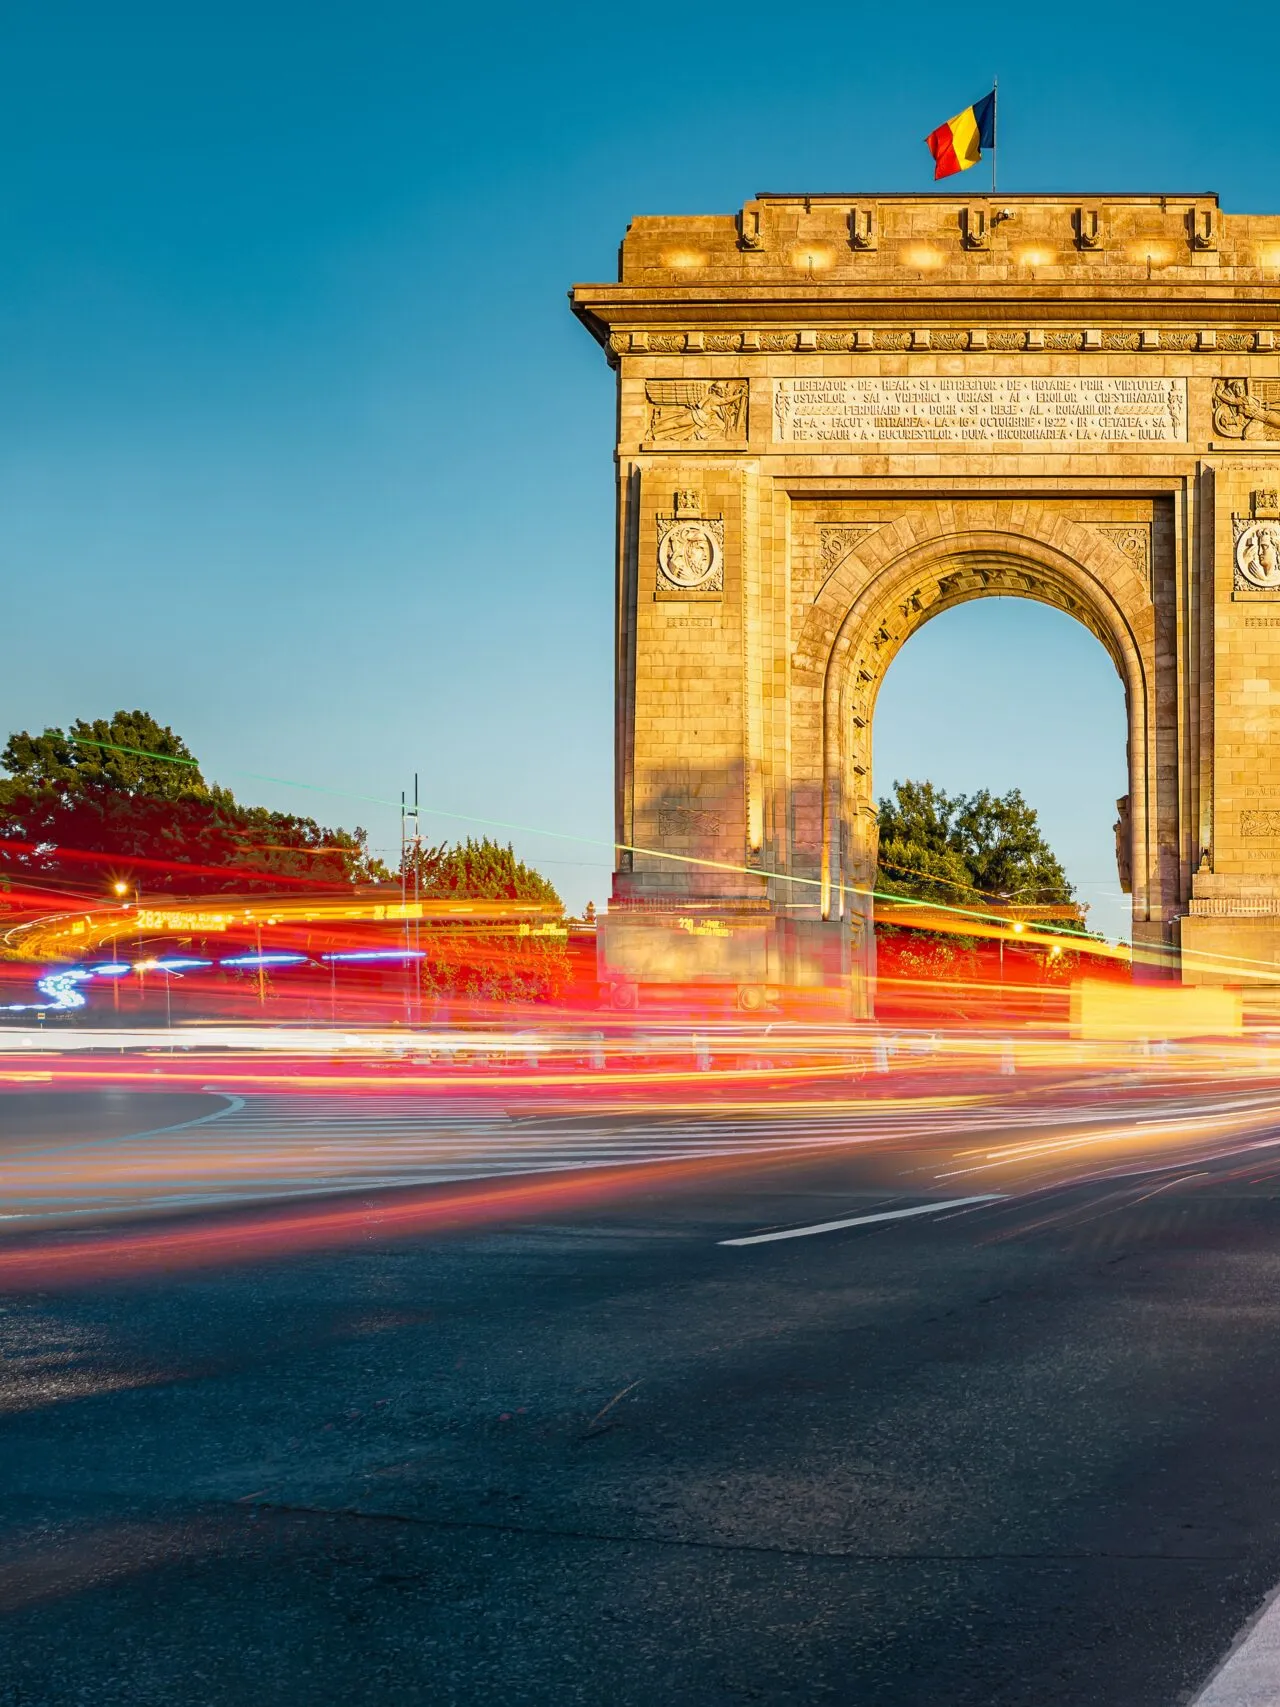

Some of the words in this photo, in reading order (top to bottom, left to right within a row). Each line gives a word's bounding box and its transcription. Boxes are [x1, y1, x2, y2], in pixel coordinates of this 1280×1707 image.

[794, 380, 847, 391] LIBERATOR
[858, 380, 872, 391] DE
[1007, 380, 1021, 391] DE
[1031, 380, 1071, 391] HOTARE
[1080, 380, 1104, 391] PRIN
[1114, 380, 1165, 391] VIRTUTEA
[895, 393, 941, 403] VREDNICI
[1009, 392, 1021, 403] AI
[1036, 392, 1078, 403] EROILOR
[844, 405, 901, 415] FERDINAND
[913, 405, 917, 415] I
[929, 405, 957, 415] DOMN
[990, 405, 1017, 415] REGE
[1029, 405, 1044, 415] AL
[934, 417, 950, 427] LA
[959, 417, 969, 427] 16
[979, 417, 1035, 427] OCTOMBRIE
[1044, 417, 1067, 427] 1922
[1098, 417, 1143, 427] CETATEA
[1152, 417, 1166, 427] SA
[793, 430, 807, 440] DE
[816, 430, 850, 440] SCAUN
[860, 430, 868, 440] A
[1077, 429, 1091, 439] LA
